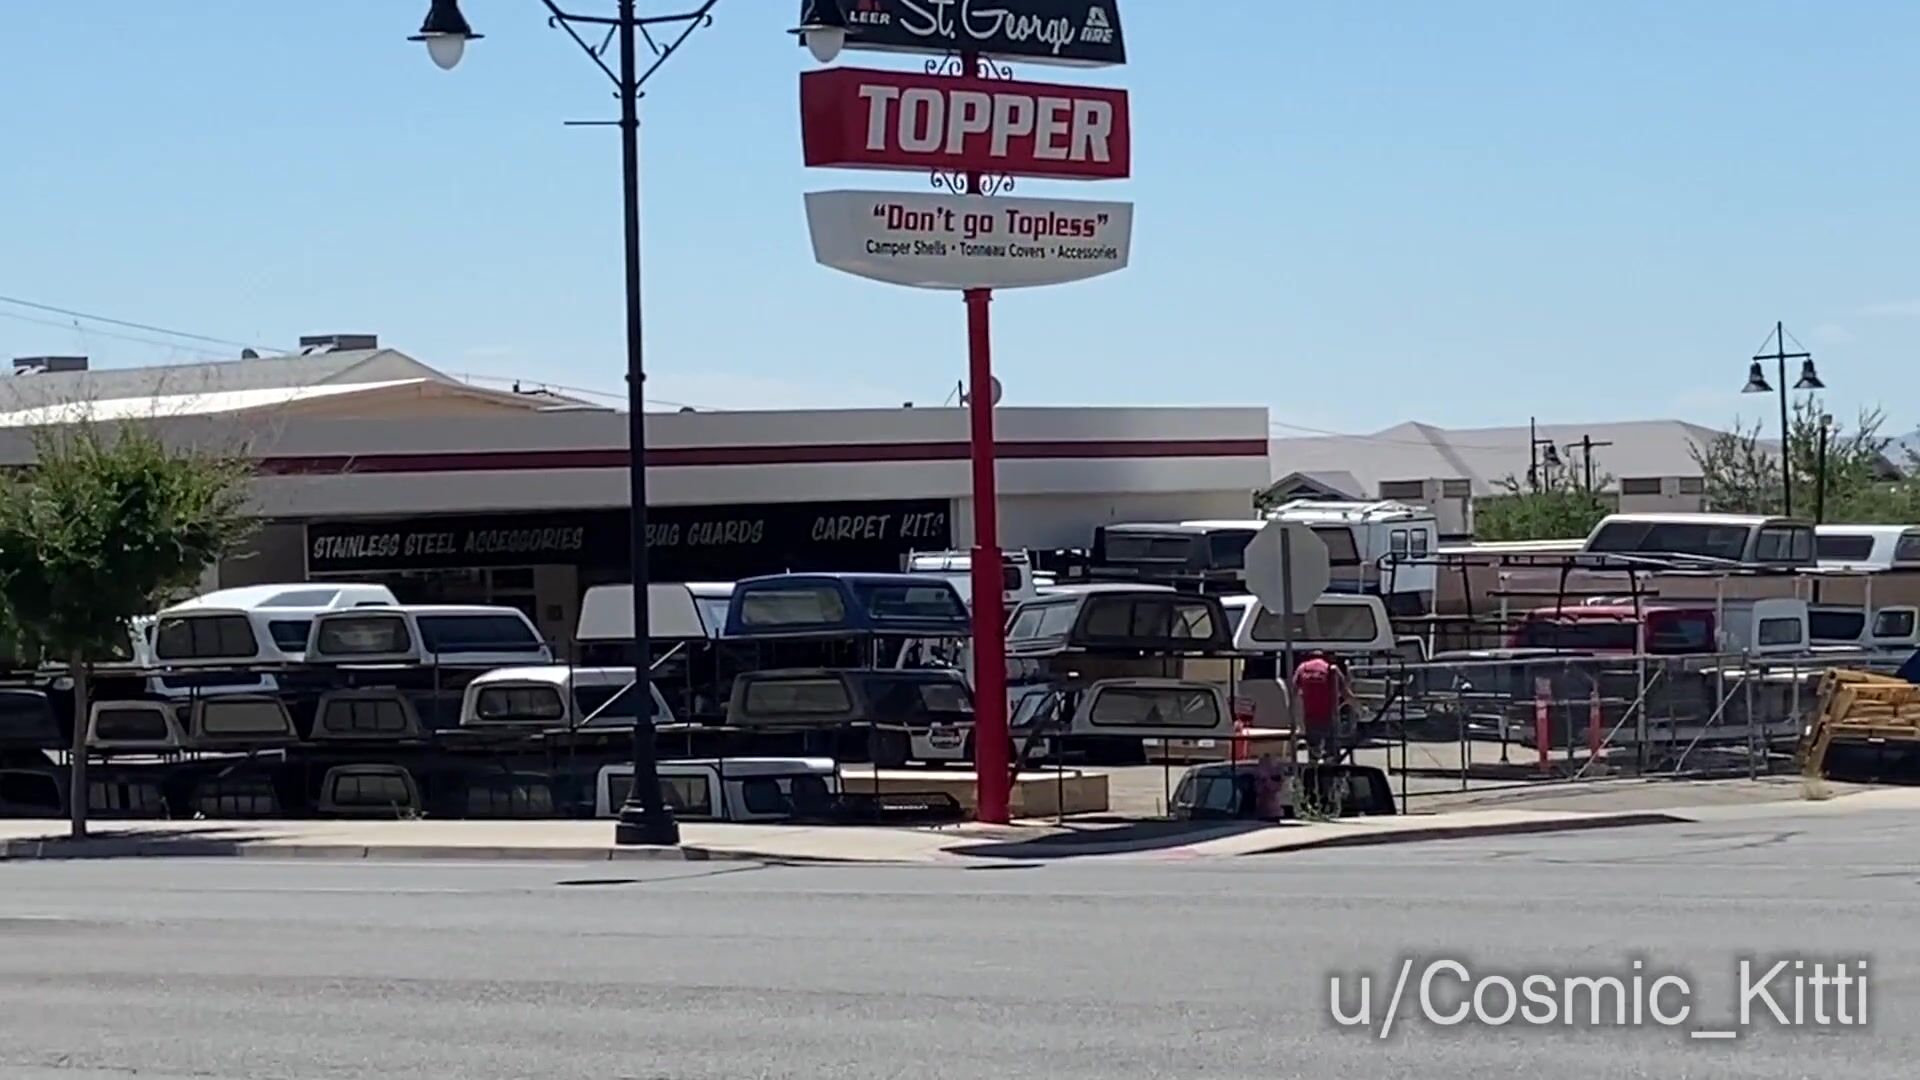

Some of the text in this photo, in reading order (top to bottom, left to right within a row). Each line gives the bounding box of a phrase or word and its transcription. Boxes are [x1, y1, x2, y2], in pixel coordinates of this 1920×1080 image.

[849, 10, 891, 24] LEER
[900, 0, 1076, 54] St. George
[858, 84, 1113, 162] TOPPER
[963, 212, 994, 240] go
[866, 239, 1118, 259] Camper Shells Tonneau Covers Accessories
[645, 519, 764, 547] BUG GUARDS
[811, 513, 945, 541] CARPET KITS
[313, 527, 584, 560] STAINLESS STEEL ACCESSORIES
